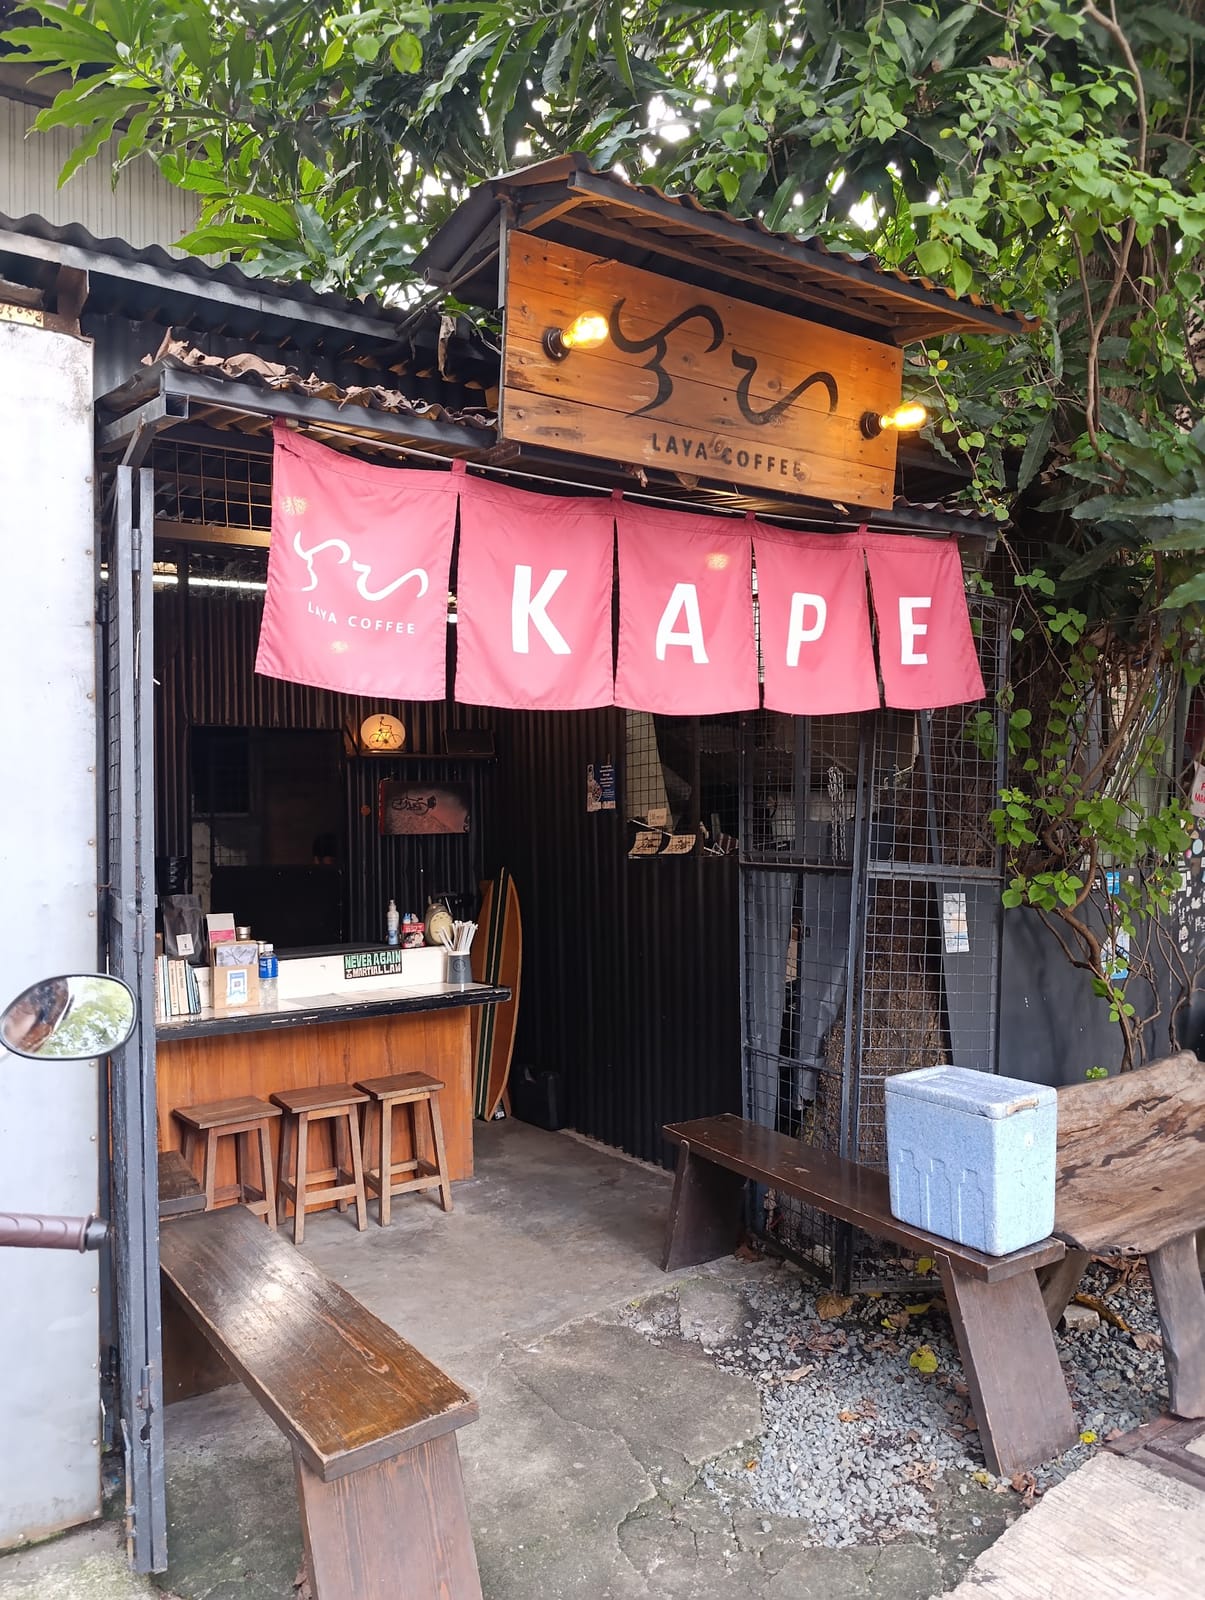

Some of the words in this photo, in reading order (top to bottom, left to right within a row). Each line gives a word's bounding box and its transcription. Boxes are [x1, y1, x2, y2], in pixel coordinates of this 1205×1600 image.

[652, 432, 708, 461] LAYA
[722, 446, 802, 478] COFFEE
[307, 600, 337, 624] LAYA
[348, 615, 415, 635] COFFEE
[345, 953, 372, 969] NEVER
[373, 950, 401, 966] AGAIN
[353, 965, 383, 977] MARTIAL
[384, 963, 401, 974] LAW
